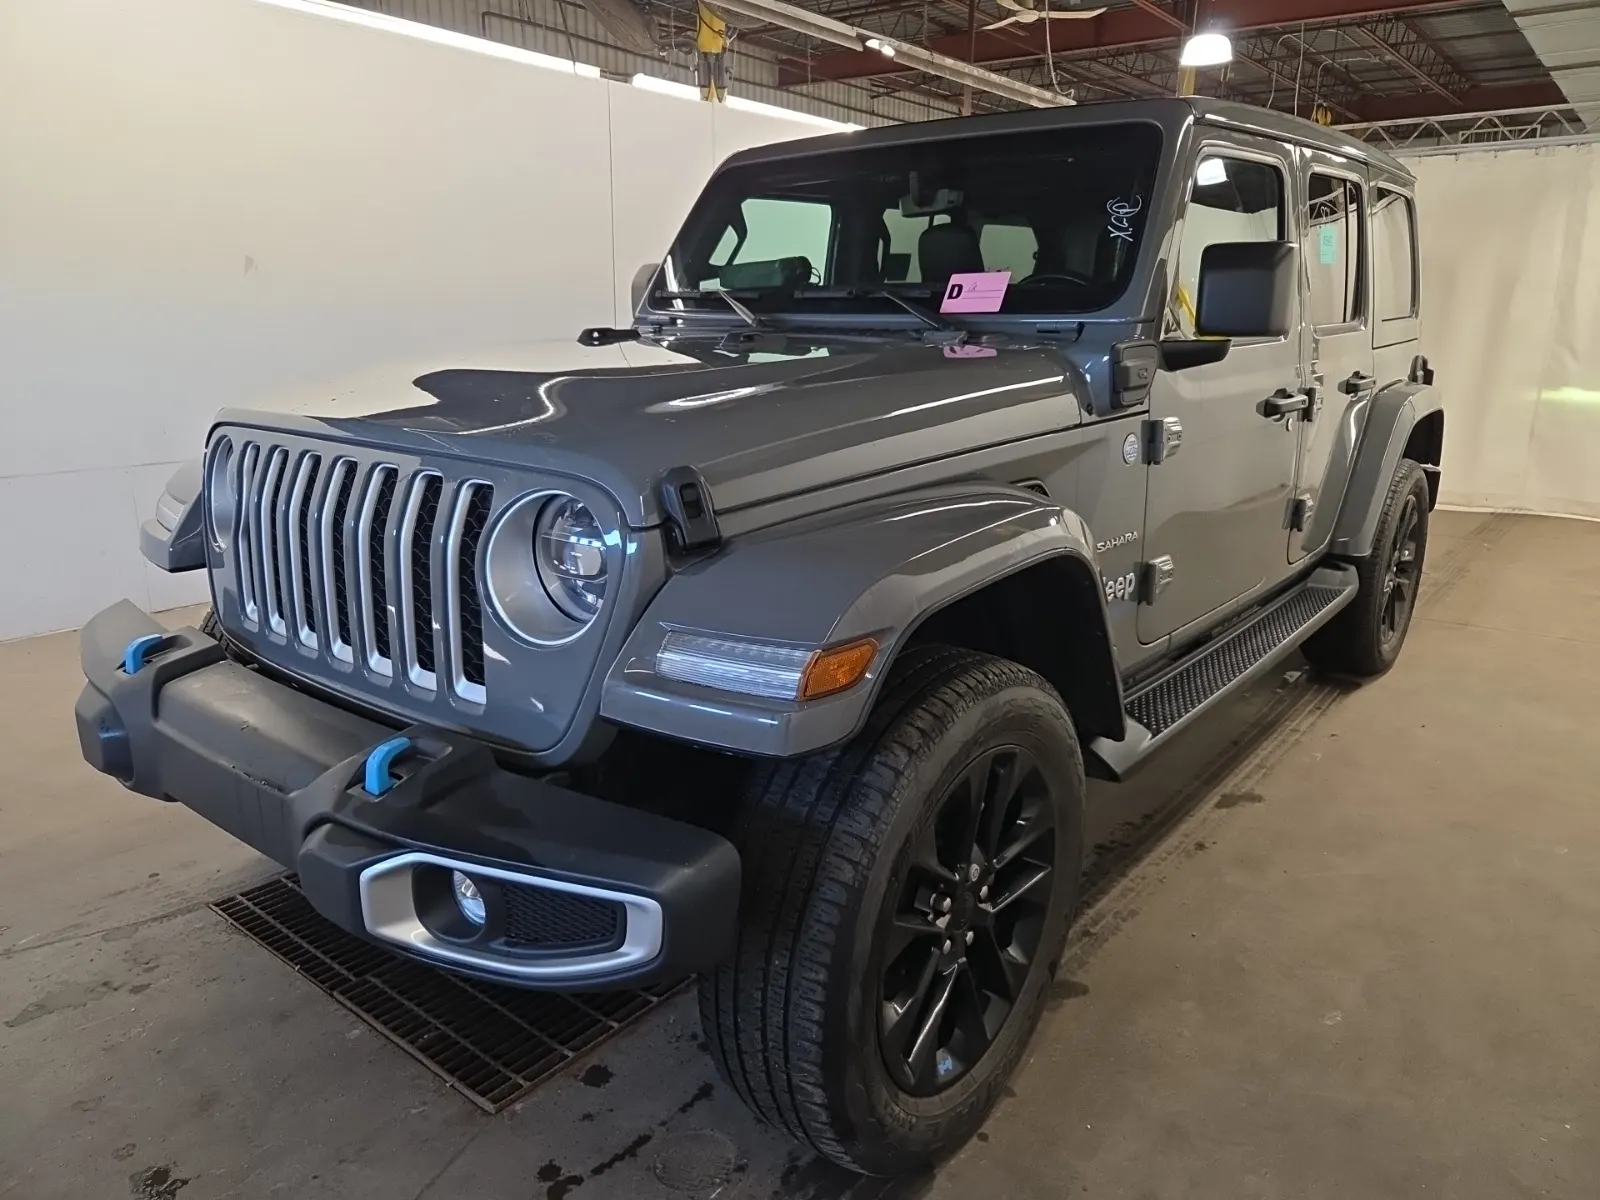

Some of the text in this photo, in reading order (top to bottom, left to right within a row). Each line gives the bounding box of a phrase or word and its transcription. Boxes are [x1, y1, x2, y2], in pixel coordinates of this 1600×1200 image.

[946, 283, 964, 300] D
[1096, 531, 1139, 553] SAHARA
[1102, 572, 1136, 602] eep
